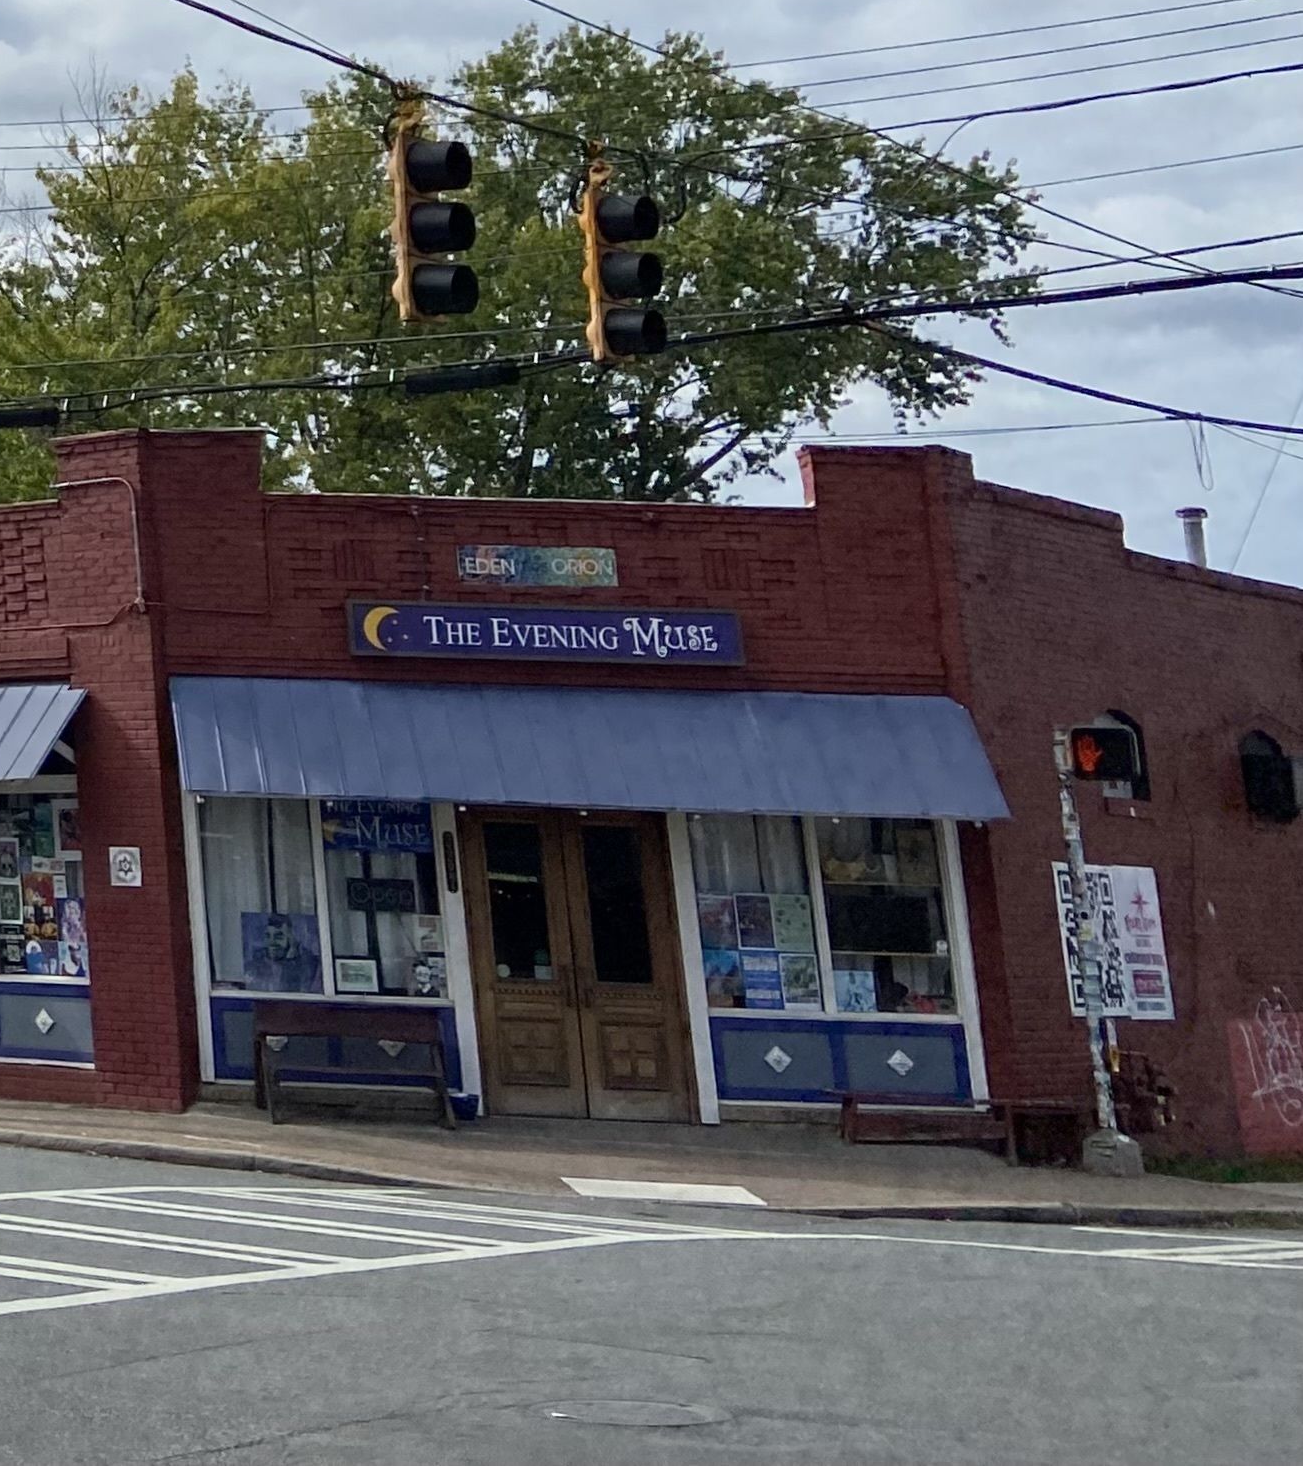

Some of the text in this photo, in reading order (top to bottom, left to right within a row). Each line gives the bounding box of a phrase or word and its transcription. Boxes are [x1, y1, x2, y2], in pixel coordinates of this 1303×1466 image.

[465, 557, 614, 576] EDEN ORION
[422, 616, 719, 659] THE EVENING MUSE
